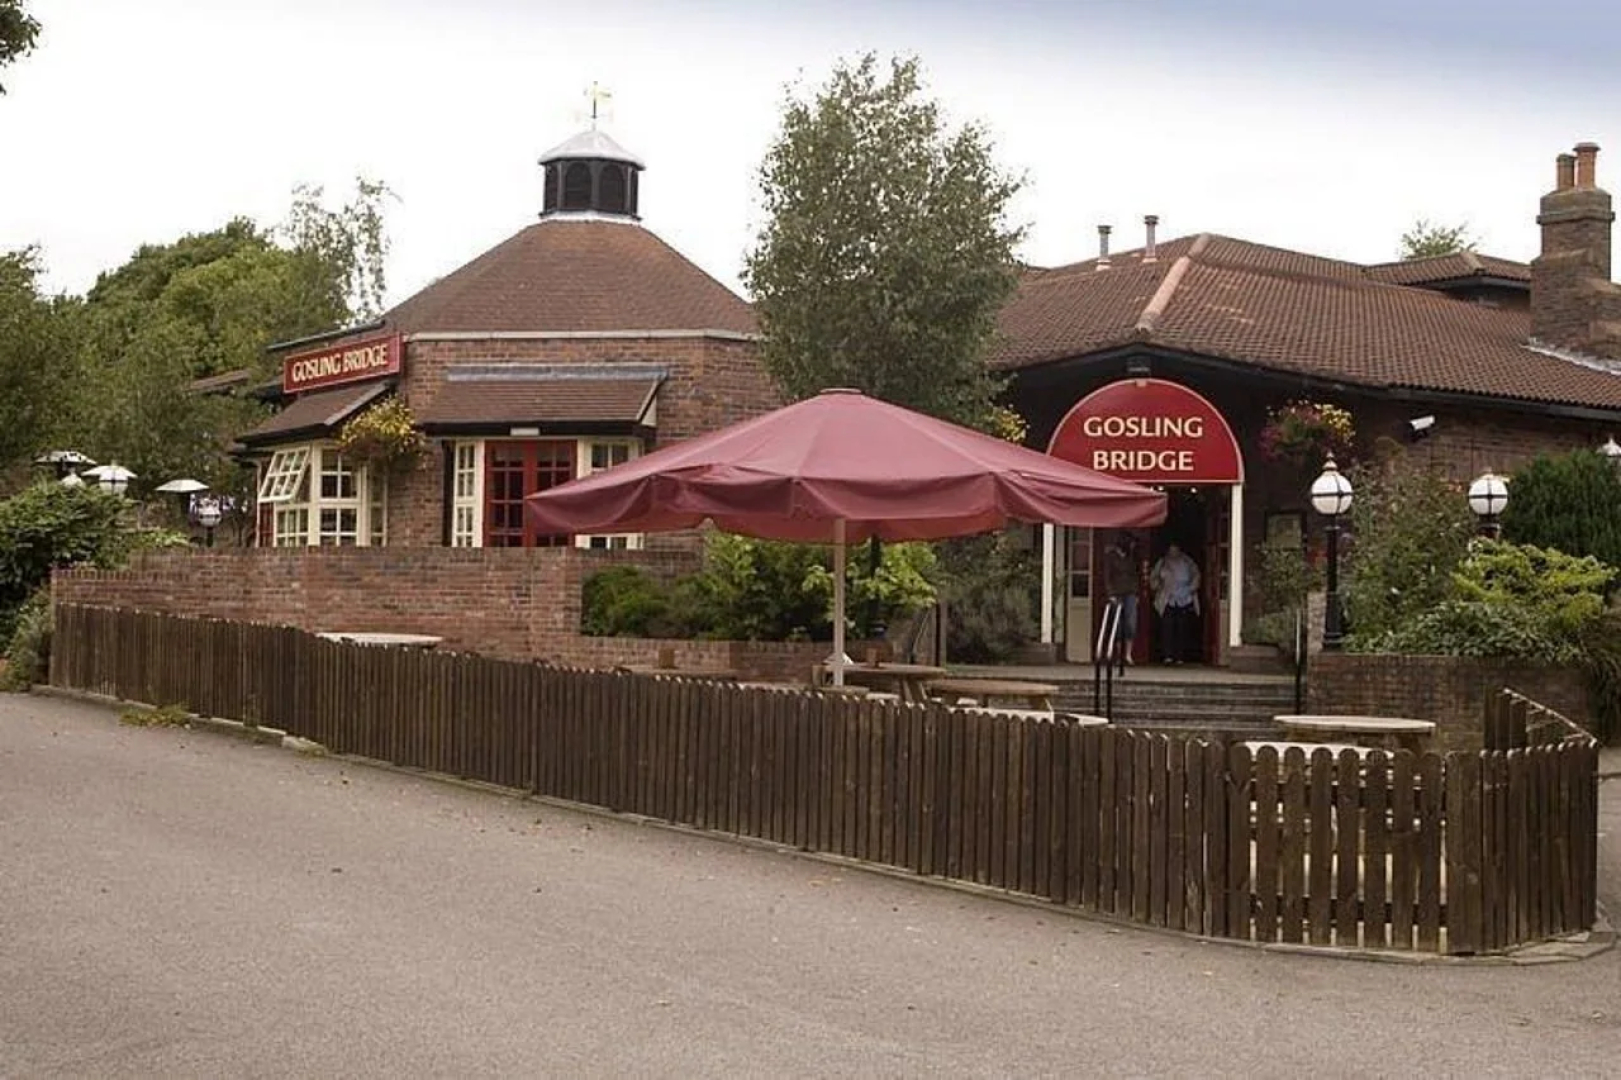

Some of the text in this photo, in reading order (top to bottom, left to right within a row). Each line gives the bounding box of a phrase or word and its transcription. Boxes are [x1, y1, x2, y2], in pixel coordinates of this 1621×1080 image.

[293, 343, 388, 382] GOSLING BRIDGE
[1083, 416, 1204, 438] GOSLING
[1093, 450, 1194, 471] BRIDGE
